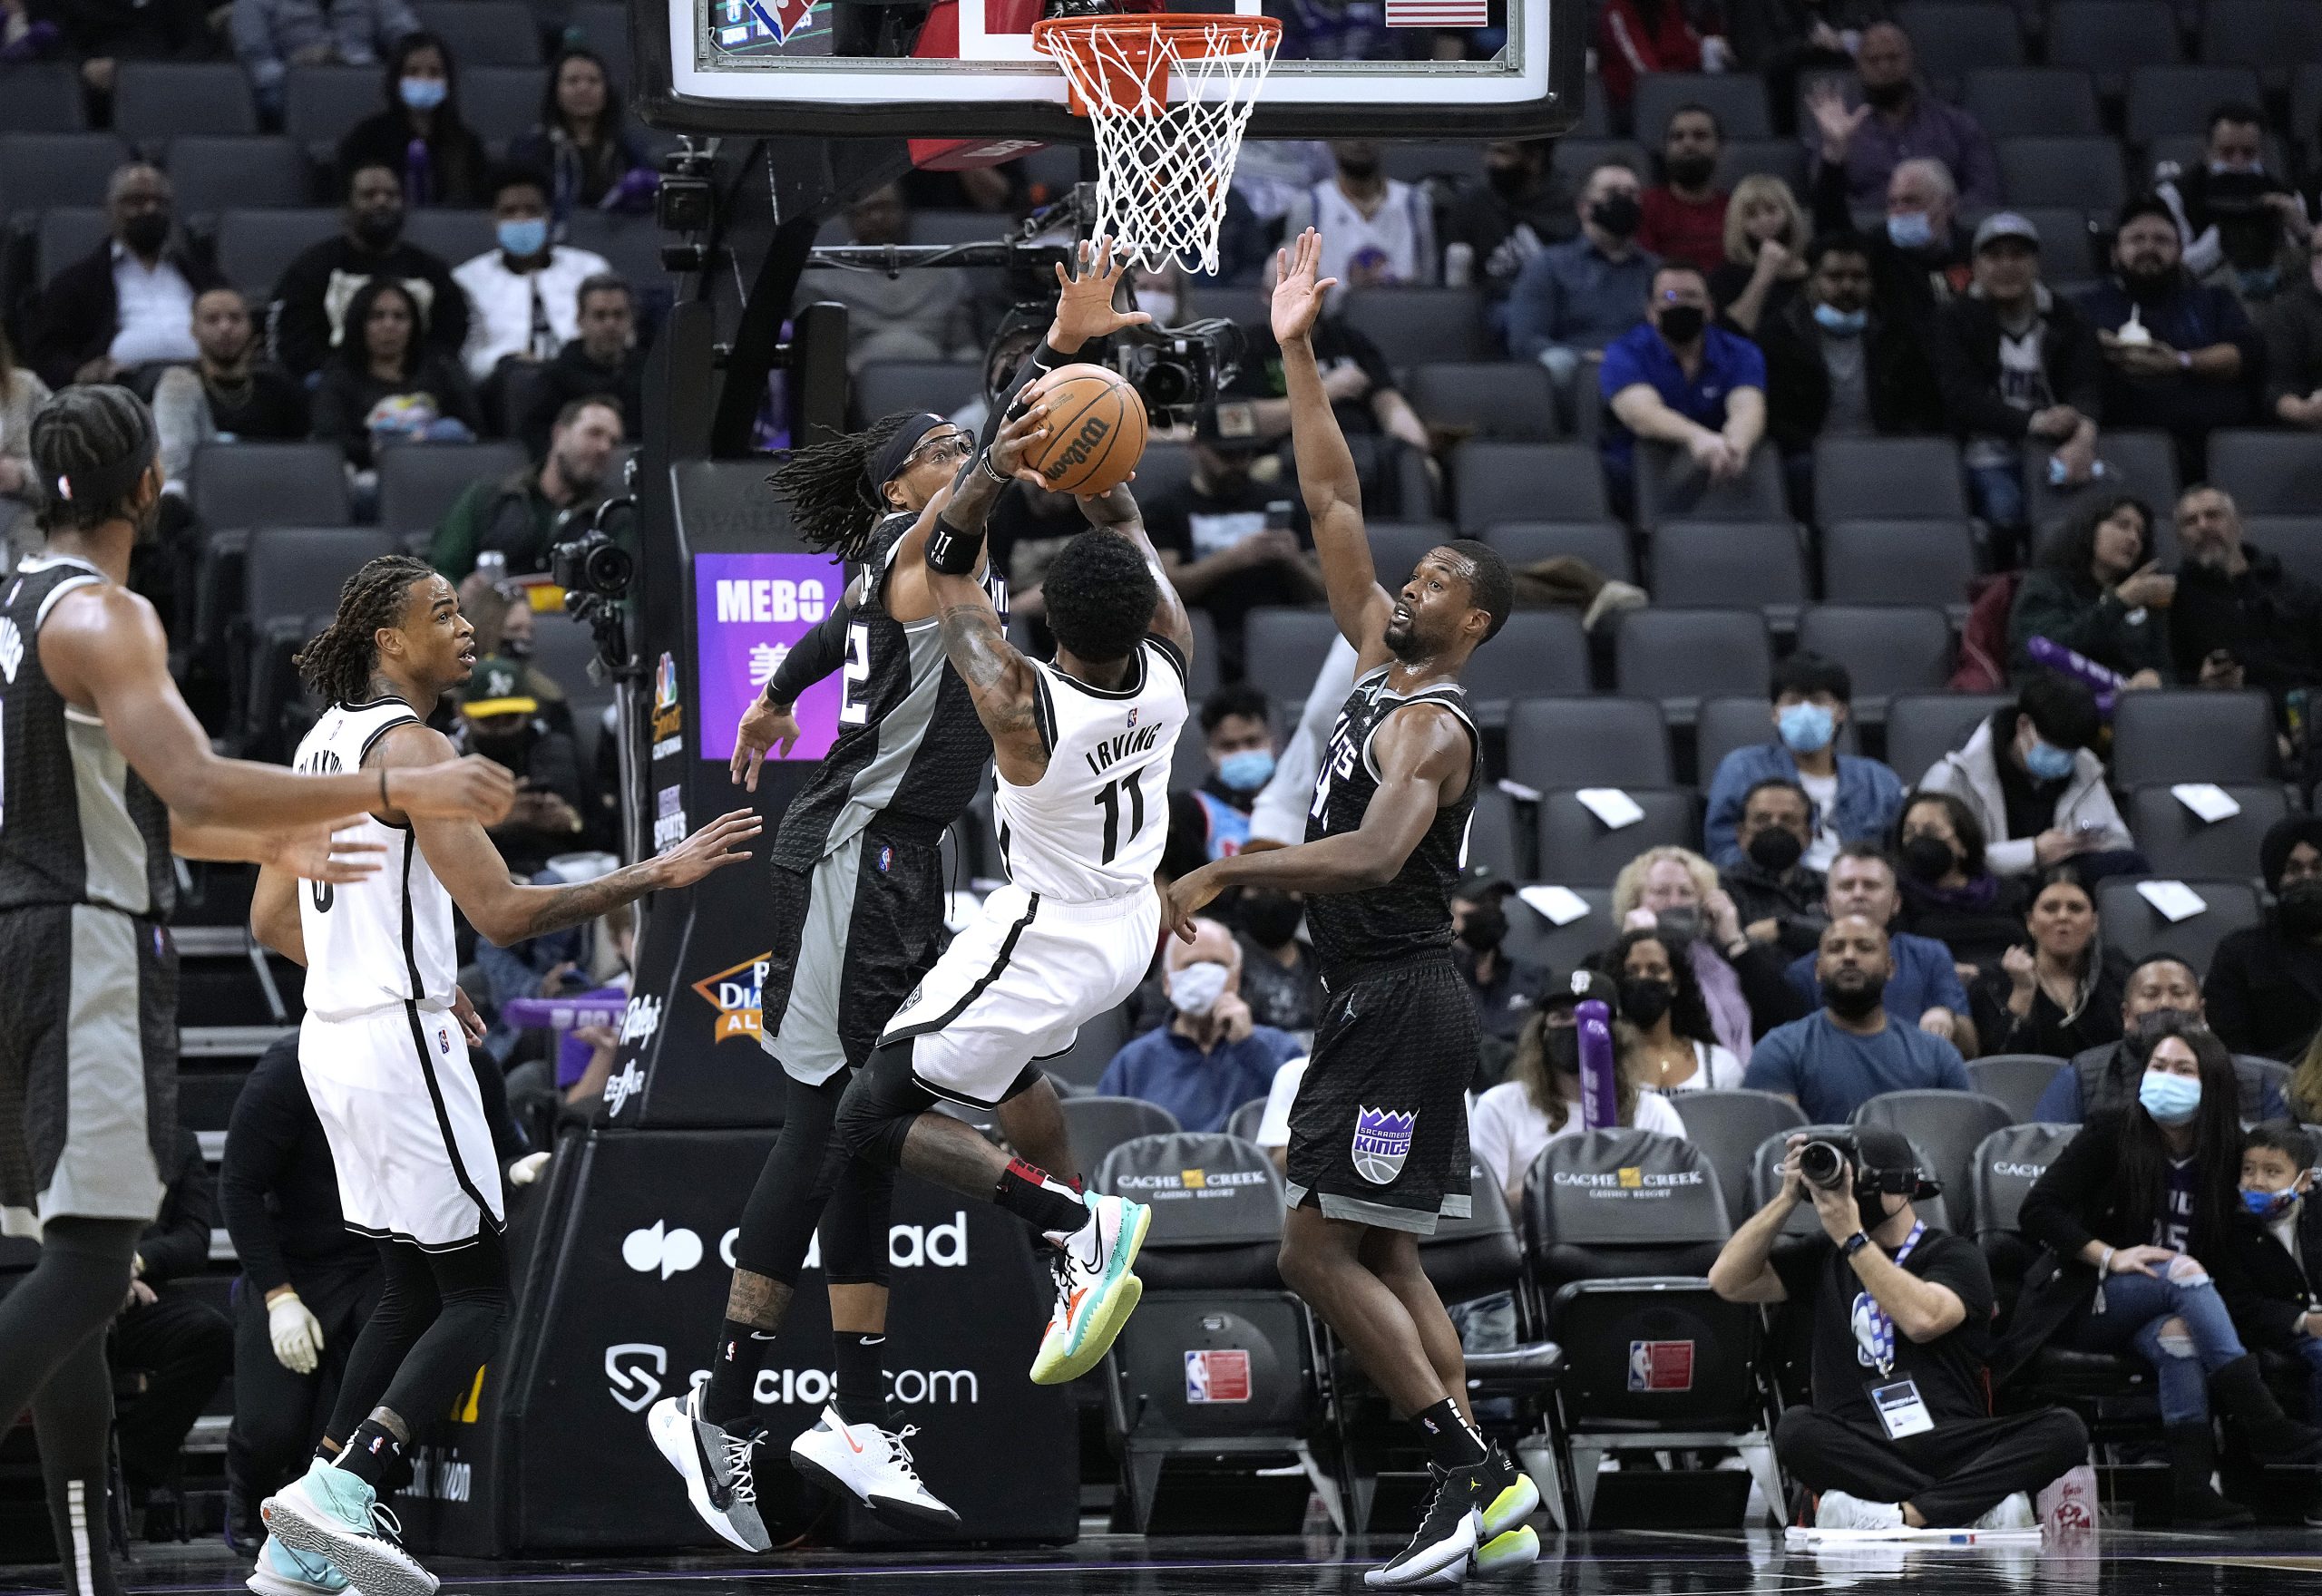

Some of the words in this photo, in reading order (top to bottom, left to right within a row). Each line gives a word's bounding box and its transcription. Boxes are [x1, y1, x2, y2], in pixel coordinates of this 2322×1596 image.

[1043, 416, 1110, 482] Wilson
[934, 530, 952, 556] 11
[716, 579, 824, 623] MEBO
[1086, 722, 1163, 776] IRVING
[1094, 765, 1146, 866] 11
[1354, 1135, 1410, 1155] KINGS
[1361, 1127, 1411, 1139] SACRAMENTO
[1117, 1174, 1180, 1190] CACHE
[1205, 1171, 1267, 1188] CREEK
[1553, 1171, 1617, 1187] CACHE
[1643, 1171, 1703, 1187] CREEK
